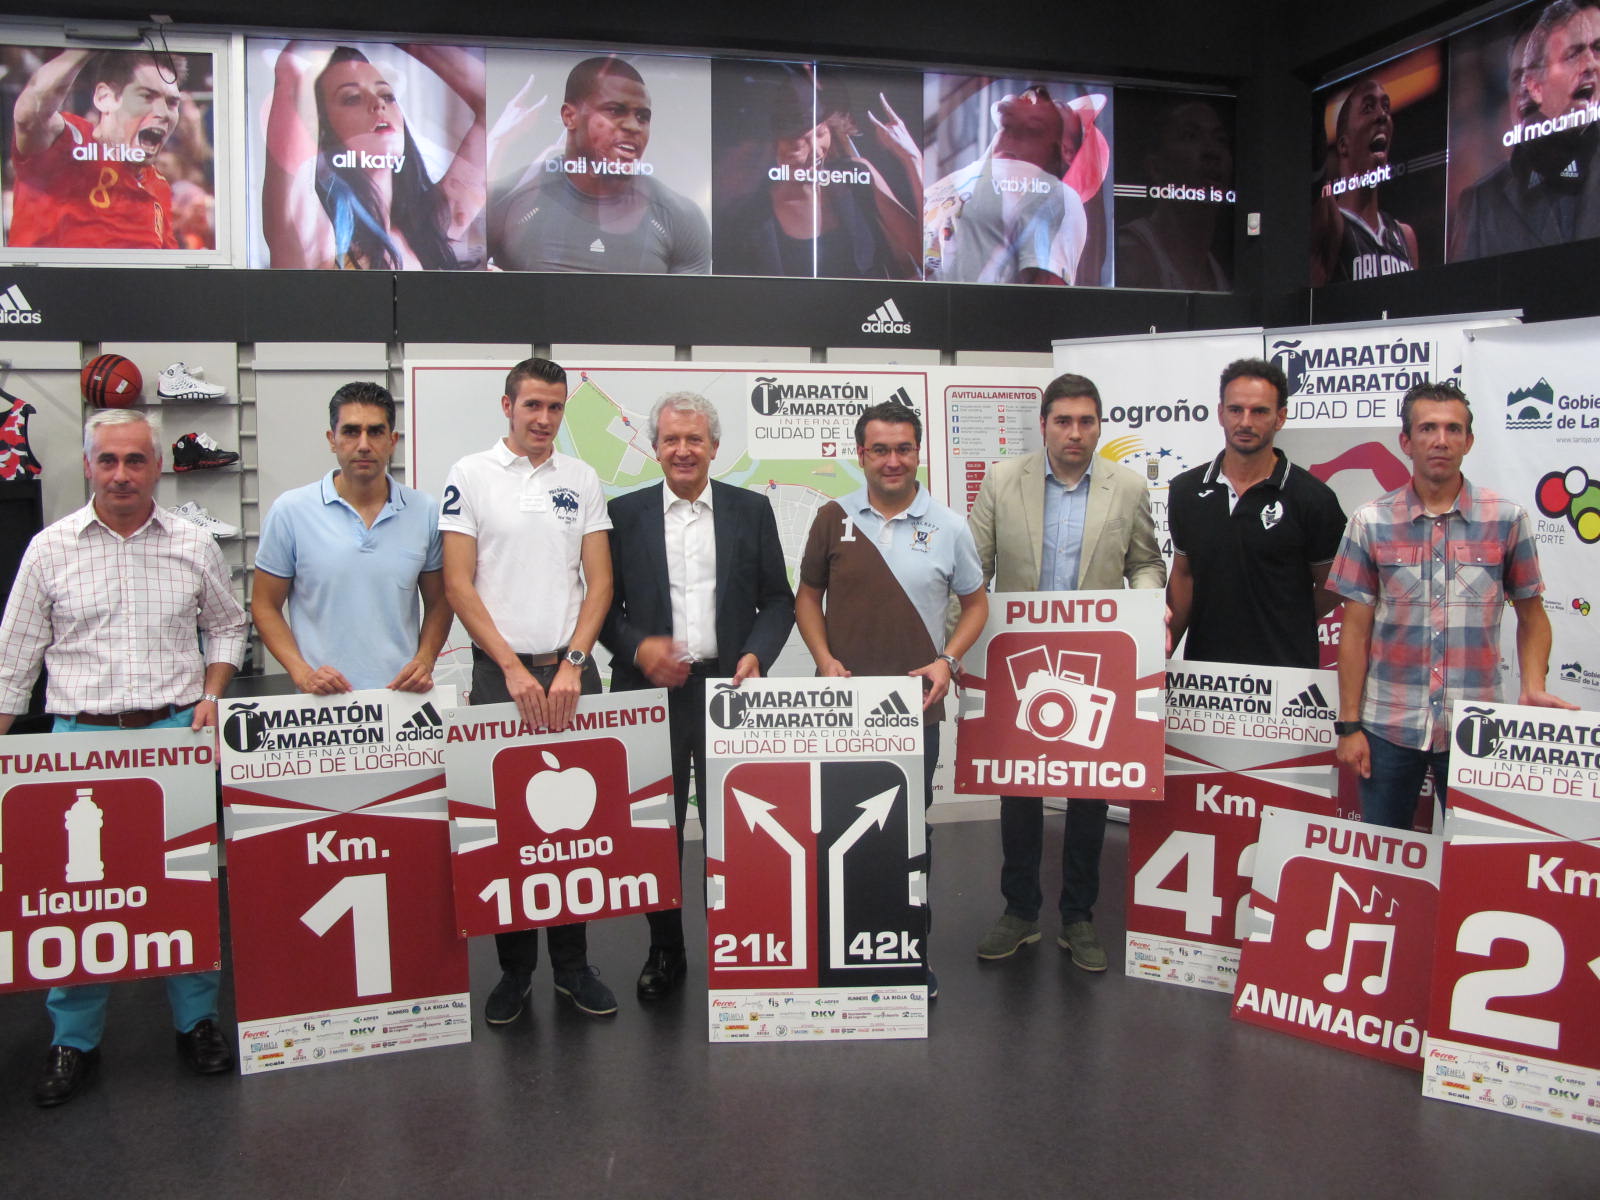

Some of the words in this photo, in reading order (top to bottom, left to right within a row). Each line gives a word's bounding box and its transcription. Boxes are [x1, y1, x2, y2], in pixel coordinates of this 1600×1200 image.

[1525, 101, 1600, 141] mourinh
[72, 145, 97, 161] all
[103, 144, 146, 162] kike
[333, 152, 356, 169] all
[361, 150, 405, 173] katy
[89, 167, 118, 208] 8
[768, 165, 790, 182] all
[793, 167, 871, 187] eugenia
[1149, 183, 1206, 201] adidas
[1209, 186, 1223, 202] is
[861, 320, 911, 334] adidas
[1301, 338, 1430, 369] MARATÓN
[778, 382, 868, 399] MARATÓN
[951, 391, 1037, 400] AVITUALLAMIENTOS
[790, 401, 868, 416] MARATÓN
[1357, 400, 1386, 419] DE
[755, 426, 815, 440] CIUDAD
[821, 427, 840, 440] DE
[1557, 415, 1576, 429] de
[1581, 414, 1600, 429] La
[442, 485, 461, 515] 2
[840, 516, 857, 541] 1
[1538, 520, 1565, 534] RIOJA
[1006, 599, 1118, 625] PUNTO
[1166, 672, 1272, 695] MARATÓN
[741, 686, 853, 708] MARATÓN
[1178, 693, 1272, 714] MARATÓN
[1282, 706, 1337, 720] adidas
[260, 701, 383, 729] MARATÓN
[756, 709, 853, 728] MARATÓN
[864, 713, 919, 728] adidas
[1166, 708, 1299, 726] INTERNACIONAL
[276, 724, 384, 749] MARATÓN
[396, 727, 443, 742] adida
[744, 729, 882, 738] INTERNACIONAL
[1213, 720, 1236, 735] DE
[1243, 722, 1332, 744] LOGROÑO
[264, 743, 415, 761] INTERNACIONAL
[714, 739, 786, 755] CIUDAD
[794, 738, 818, 753] DE
[825, 735, 916, 753] LOGROÑO
[231, 758, 312, 780] CIUDAD
[320, 756, 346, 773] DE
[972, 754, 1146, 788] TURÍSTICO
[1457, 768, 1544, 792] CIUDAD
[1553, 778, 1583, 797] DE
[307, 830, 390, 865] Km.
[520, 836, 613, 866] SÓLIDO
[1305, 823, 1428, 869] PUNTO
[21, 885, 148, 917] LÍQUIDO
[478, 867, 660, 926] 100m
[300, 873, 392, 998] 1
[849, 931, 921, 961] 42k
[714, 933, 788, 963] 21k
[1449, 910, 1600, 1050] 2
[712, 999, 737, 1008] Ferrer
[811, 1010, 836, 1018] DKV
[242, 1029, 270, 1040] Ferrer
[350, 1026, 376, 1036] DKV
[1429, 1048, 1459, 1063] Ferrer
[1497, 1060, 1510, 1074] fis
[1548, 1087, 1580, 1100] DKV
